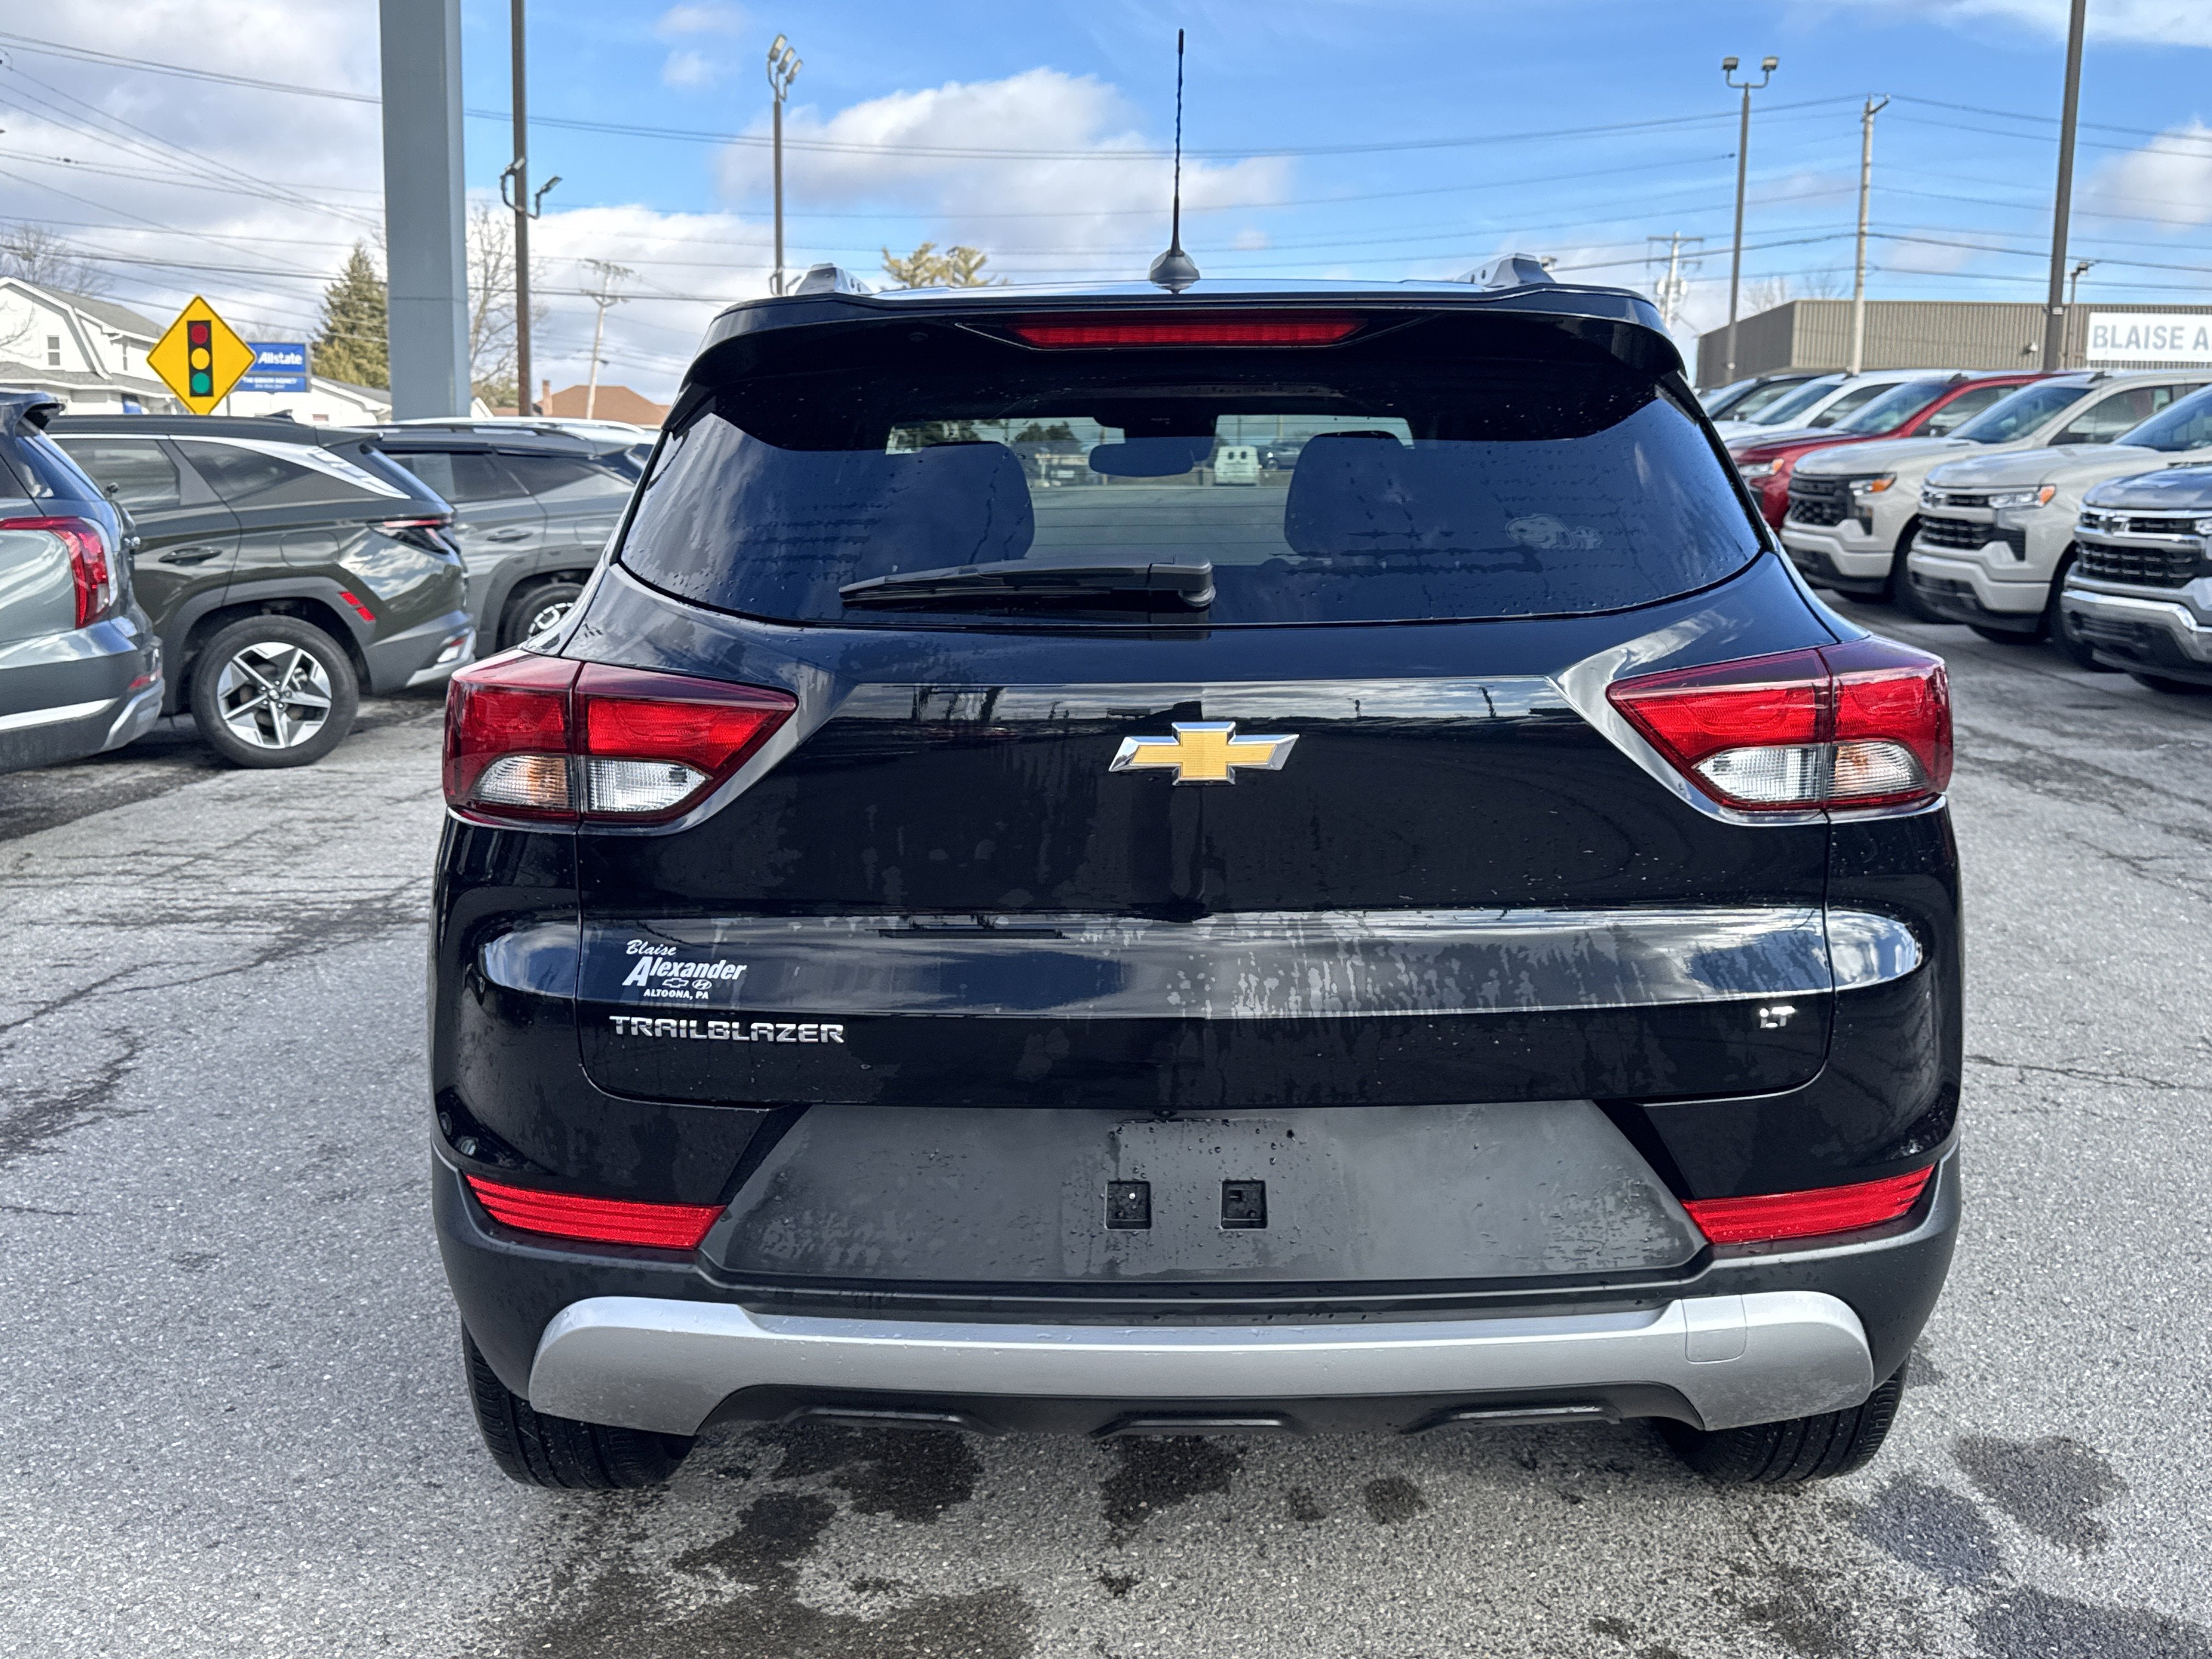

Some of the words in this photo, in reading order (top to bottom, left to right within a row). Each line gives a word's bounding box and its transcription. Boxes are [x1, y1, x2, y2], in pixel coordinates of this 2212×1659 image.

[2092, 324, 2185, 349] BLAISE
[2192, 325, 2212, 350] A
[258, 351, 303, 365] Allstate
[626, 939, 676, 956] Blaise
[622, 956, 747, 986] Alexander
[644, 989, 693, 1000] ALTOONA,
[696, 990, 709, 999] PA
[609, 1015, 844, 1043] TRAILBLAZER
[1759, 1006, 1796, 1029] LT
